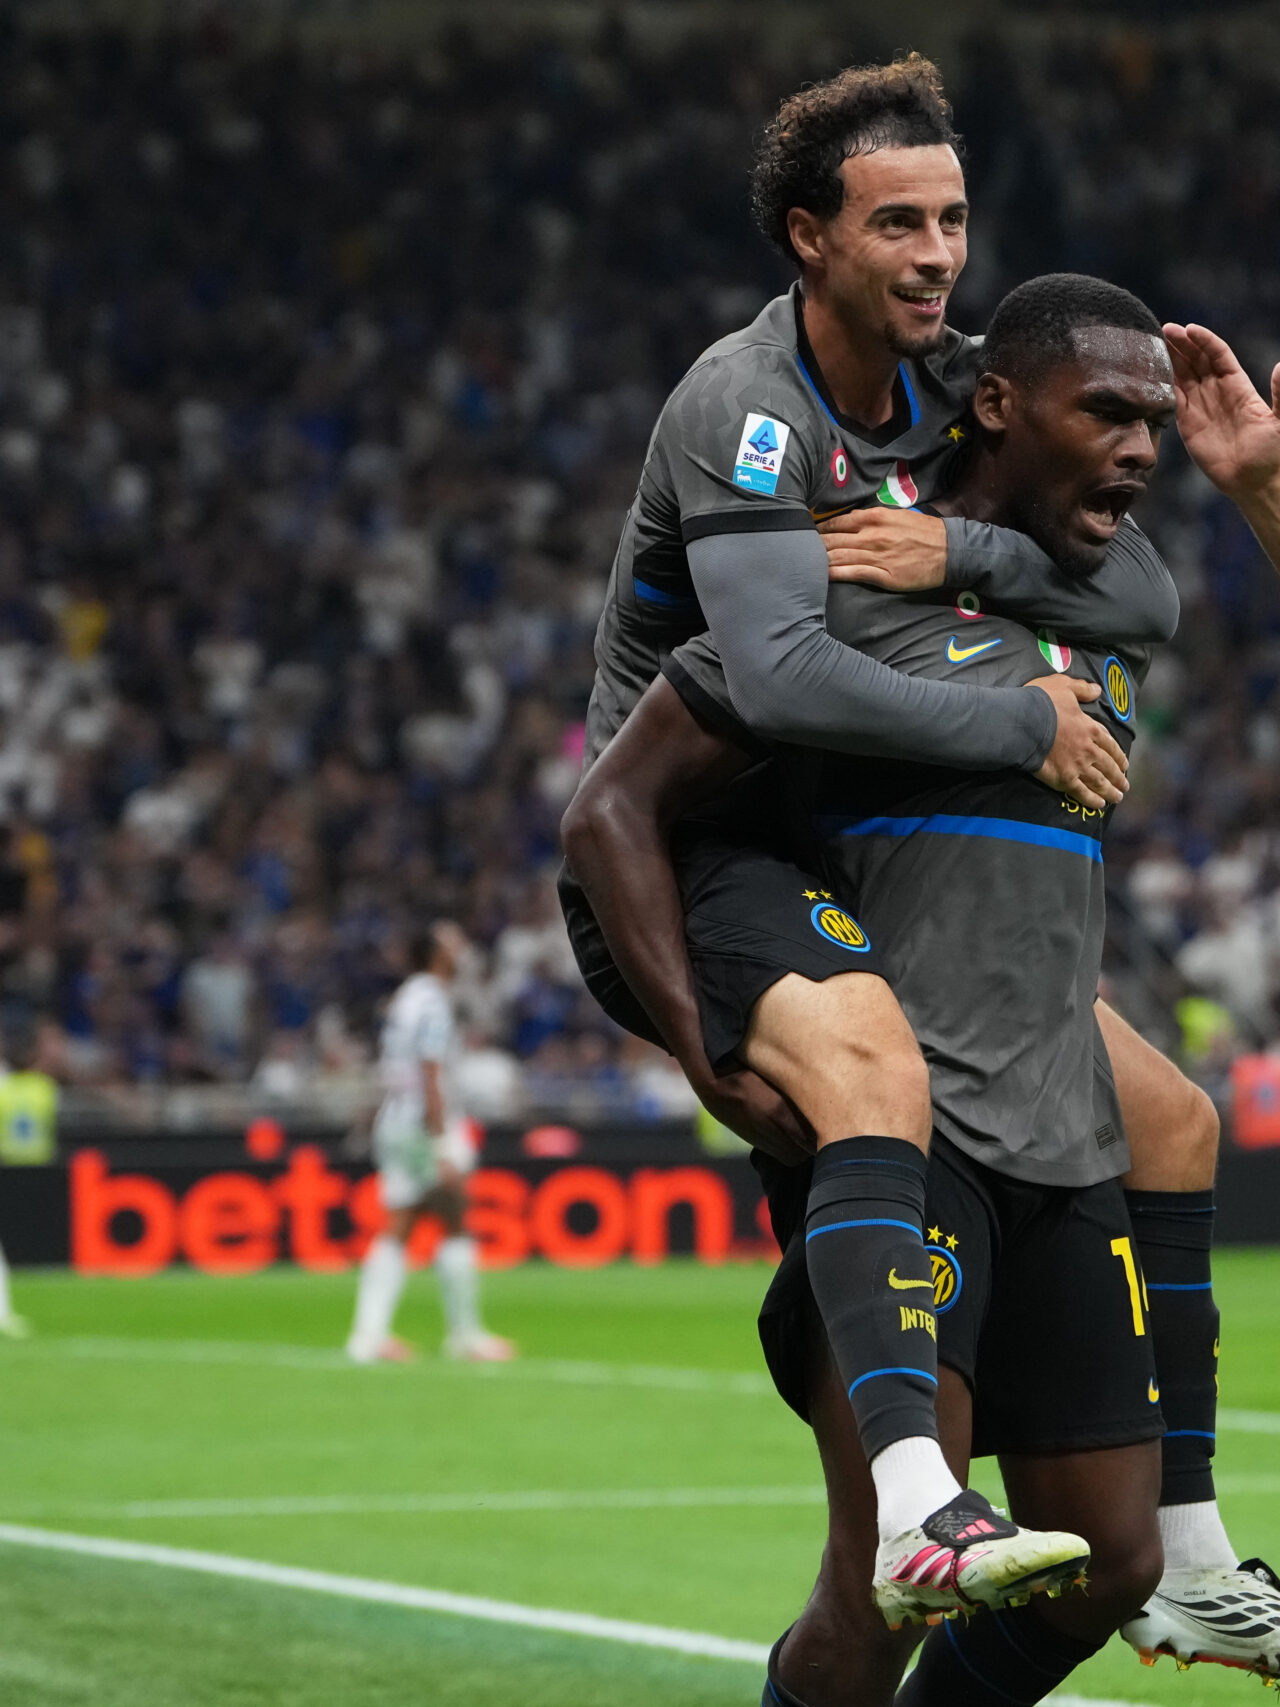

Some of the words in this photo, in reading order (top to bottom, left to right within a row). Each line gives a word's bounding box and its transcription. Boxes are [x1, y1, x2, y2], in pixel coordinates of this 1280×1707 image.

[743, 452, 768, 465] SERIE
[769, 459, 775, 467] A
[1110, 1236, 1150, 1337] 1
